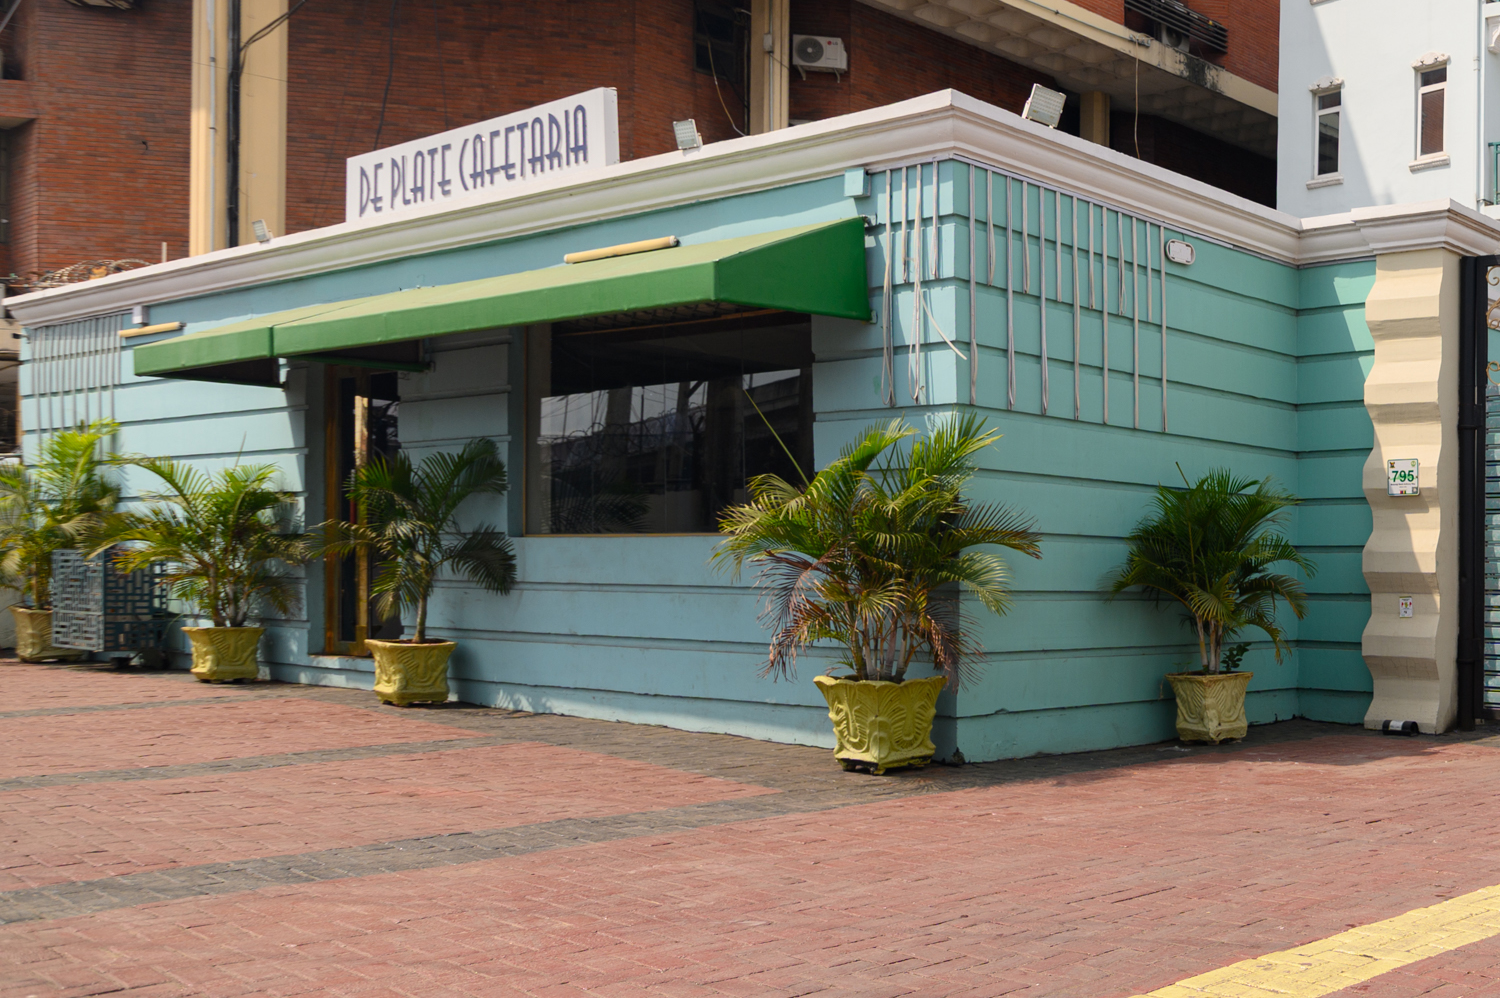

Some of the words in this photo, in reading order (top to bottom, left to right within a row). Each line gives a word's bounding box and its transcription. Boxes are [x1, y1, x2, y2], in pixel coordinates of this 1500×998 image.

[359, 162, 383, 218] DE
[390, 143, 451, 209] PLATE
[459, 104, 588, 192] CAFETARIA
[1391, 469, 1415, 483] 795
